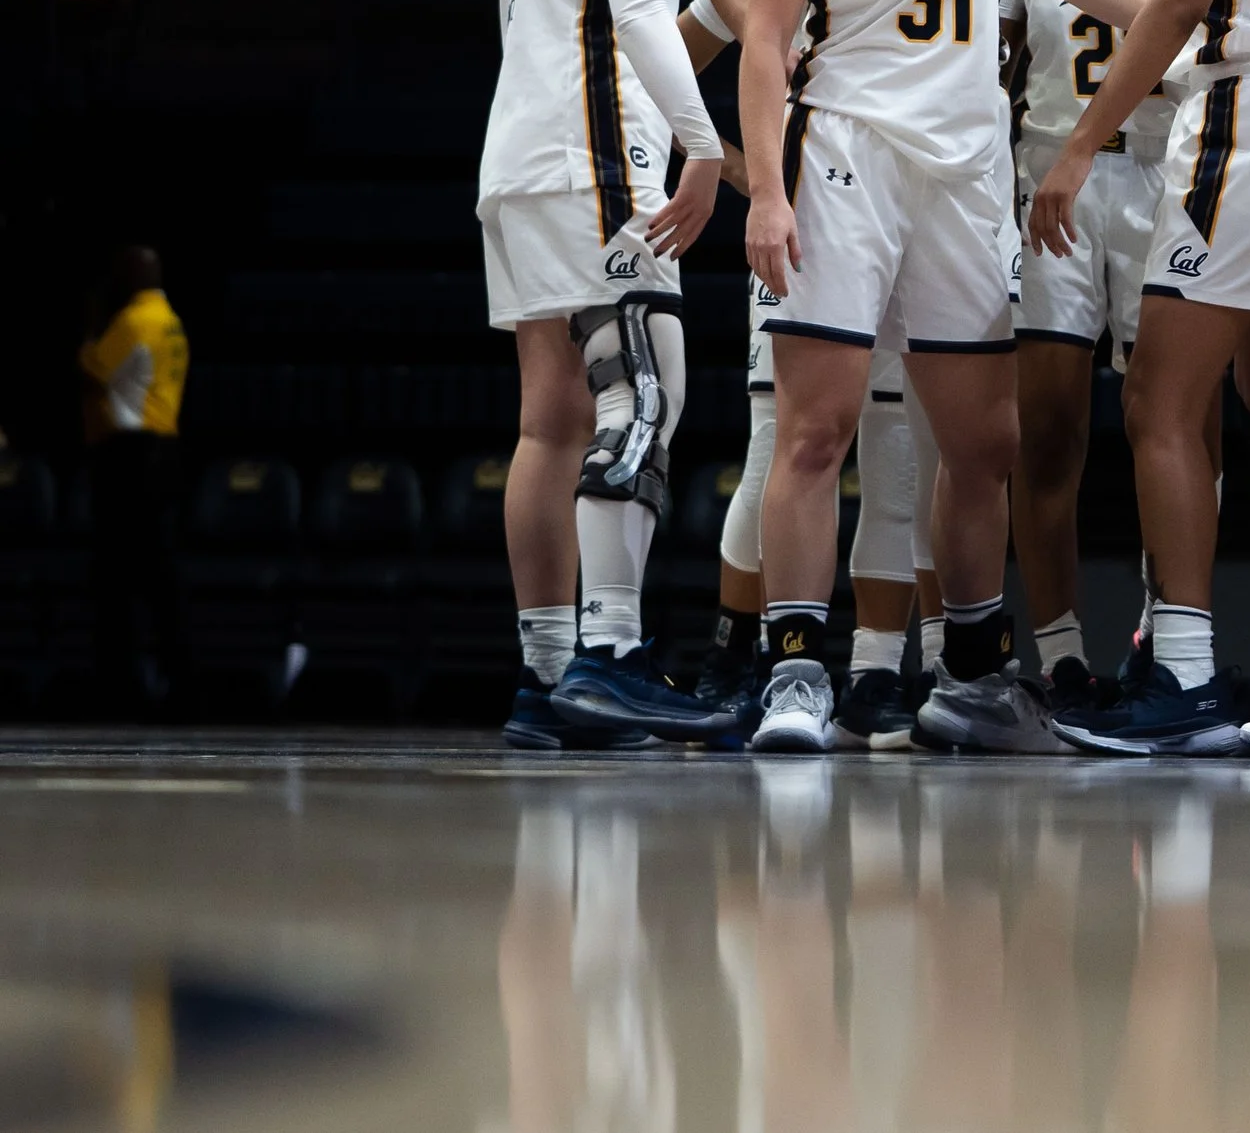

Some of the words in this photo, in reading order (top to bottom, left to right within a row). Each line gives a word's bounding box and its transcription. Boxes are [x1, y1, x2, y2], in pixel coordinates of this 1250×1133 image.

[604, 249, 641, 281] Cal
[1166, 245, 1209, 278] Cal
[783, 631, 806, 655] Cal
